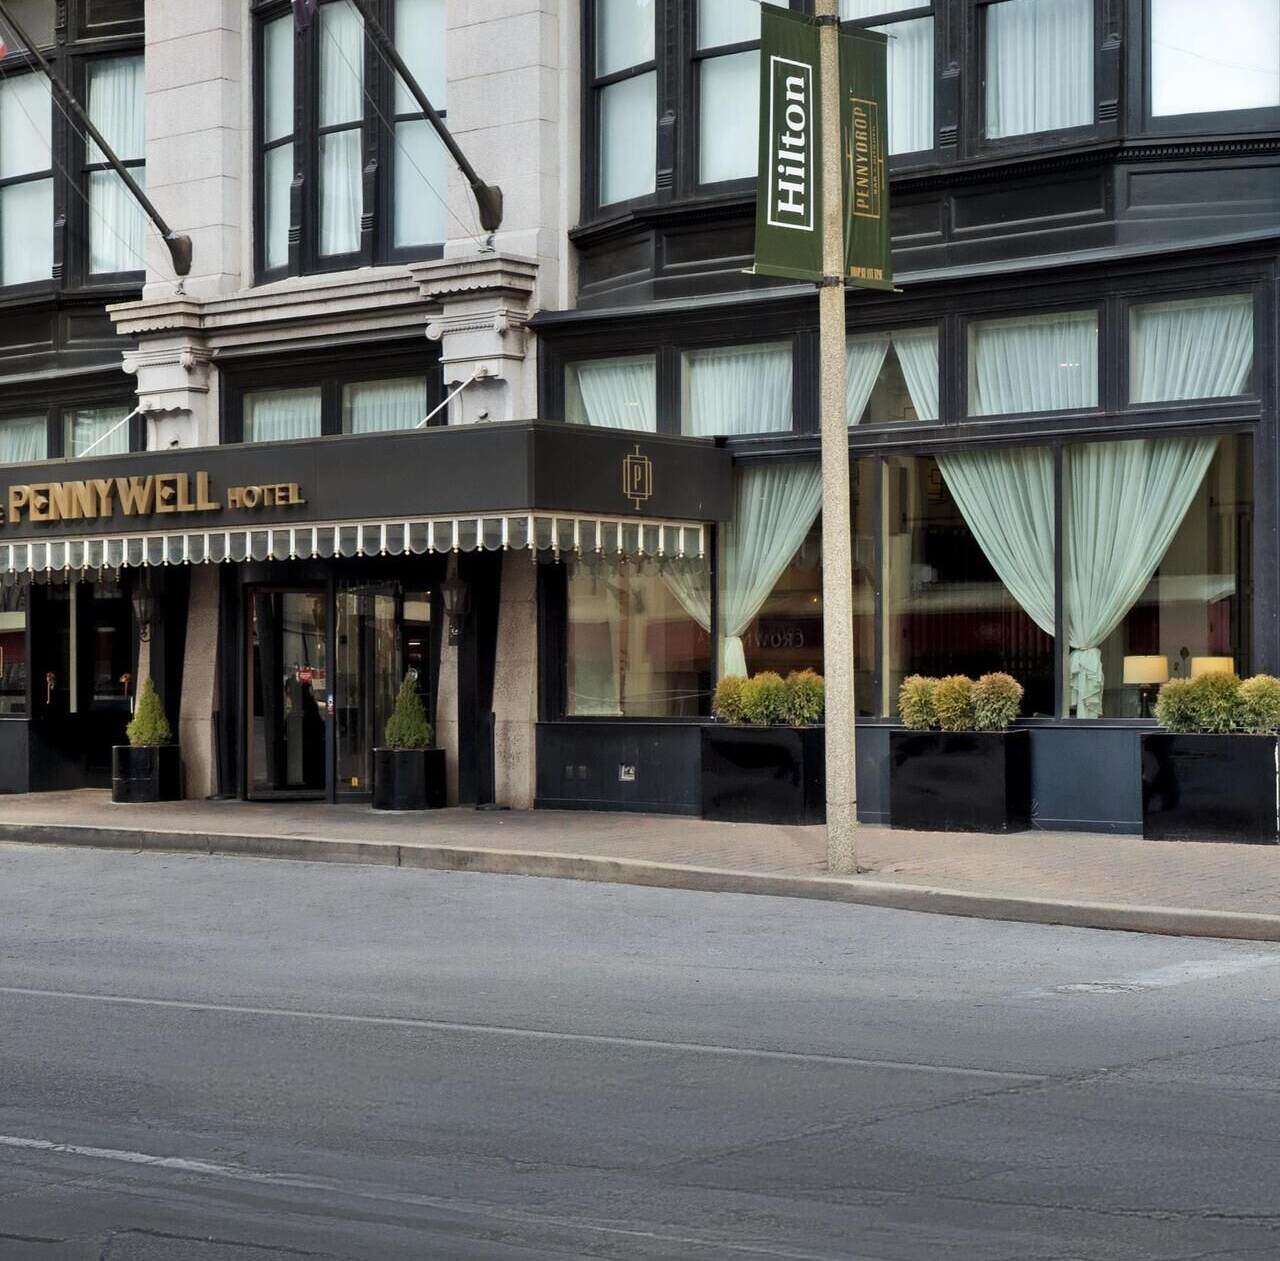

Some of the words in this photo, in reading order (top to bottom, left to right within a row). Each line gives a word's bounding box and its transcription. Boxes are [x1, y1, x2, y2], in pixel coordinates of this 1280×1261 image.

[778, 75, 806, 216] Hilton
[854, 106, 869, 209] PENNYDROP
[9, 471, 222, 523] PENNYWELL
[228, 482, 306, 509] HOTEL
